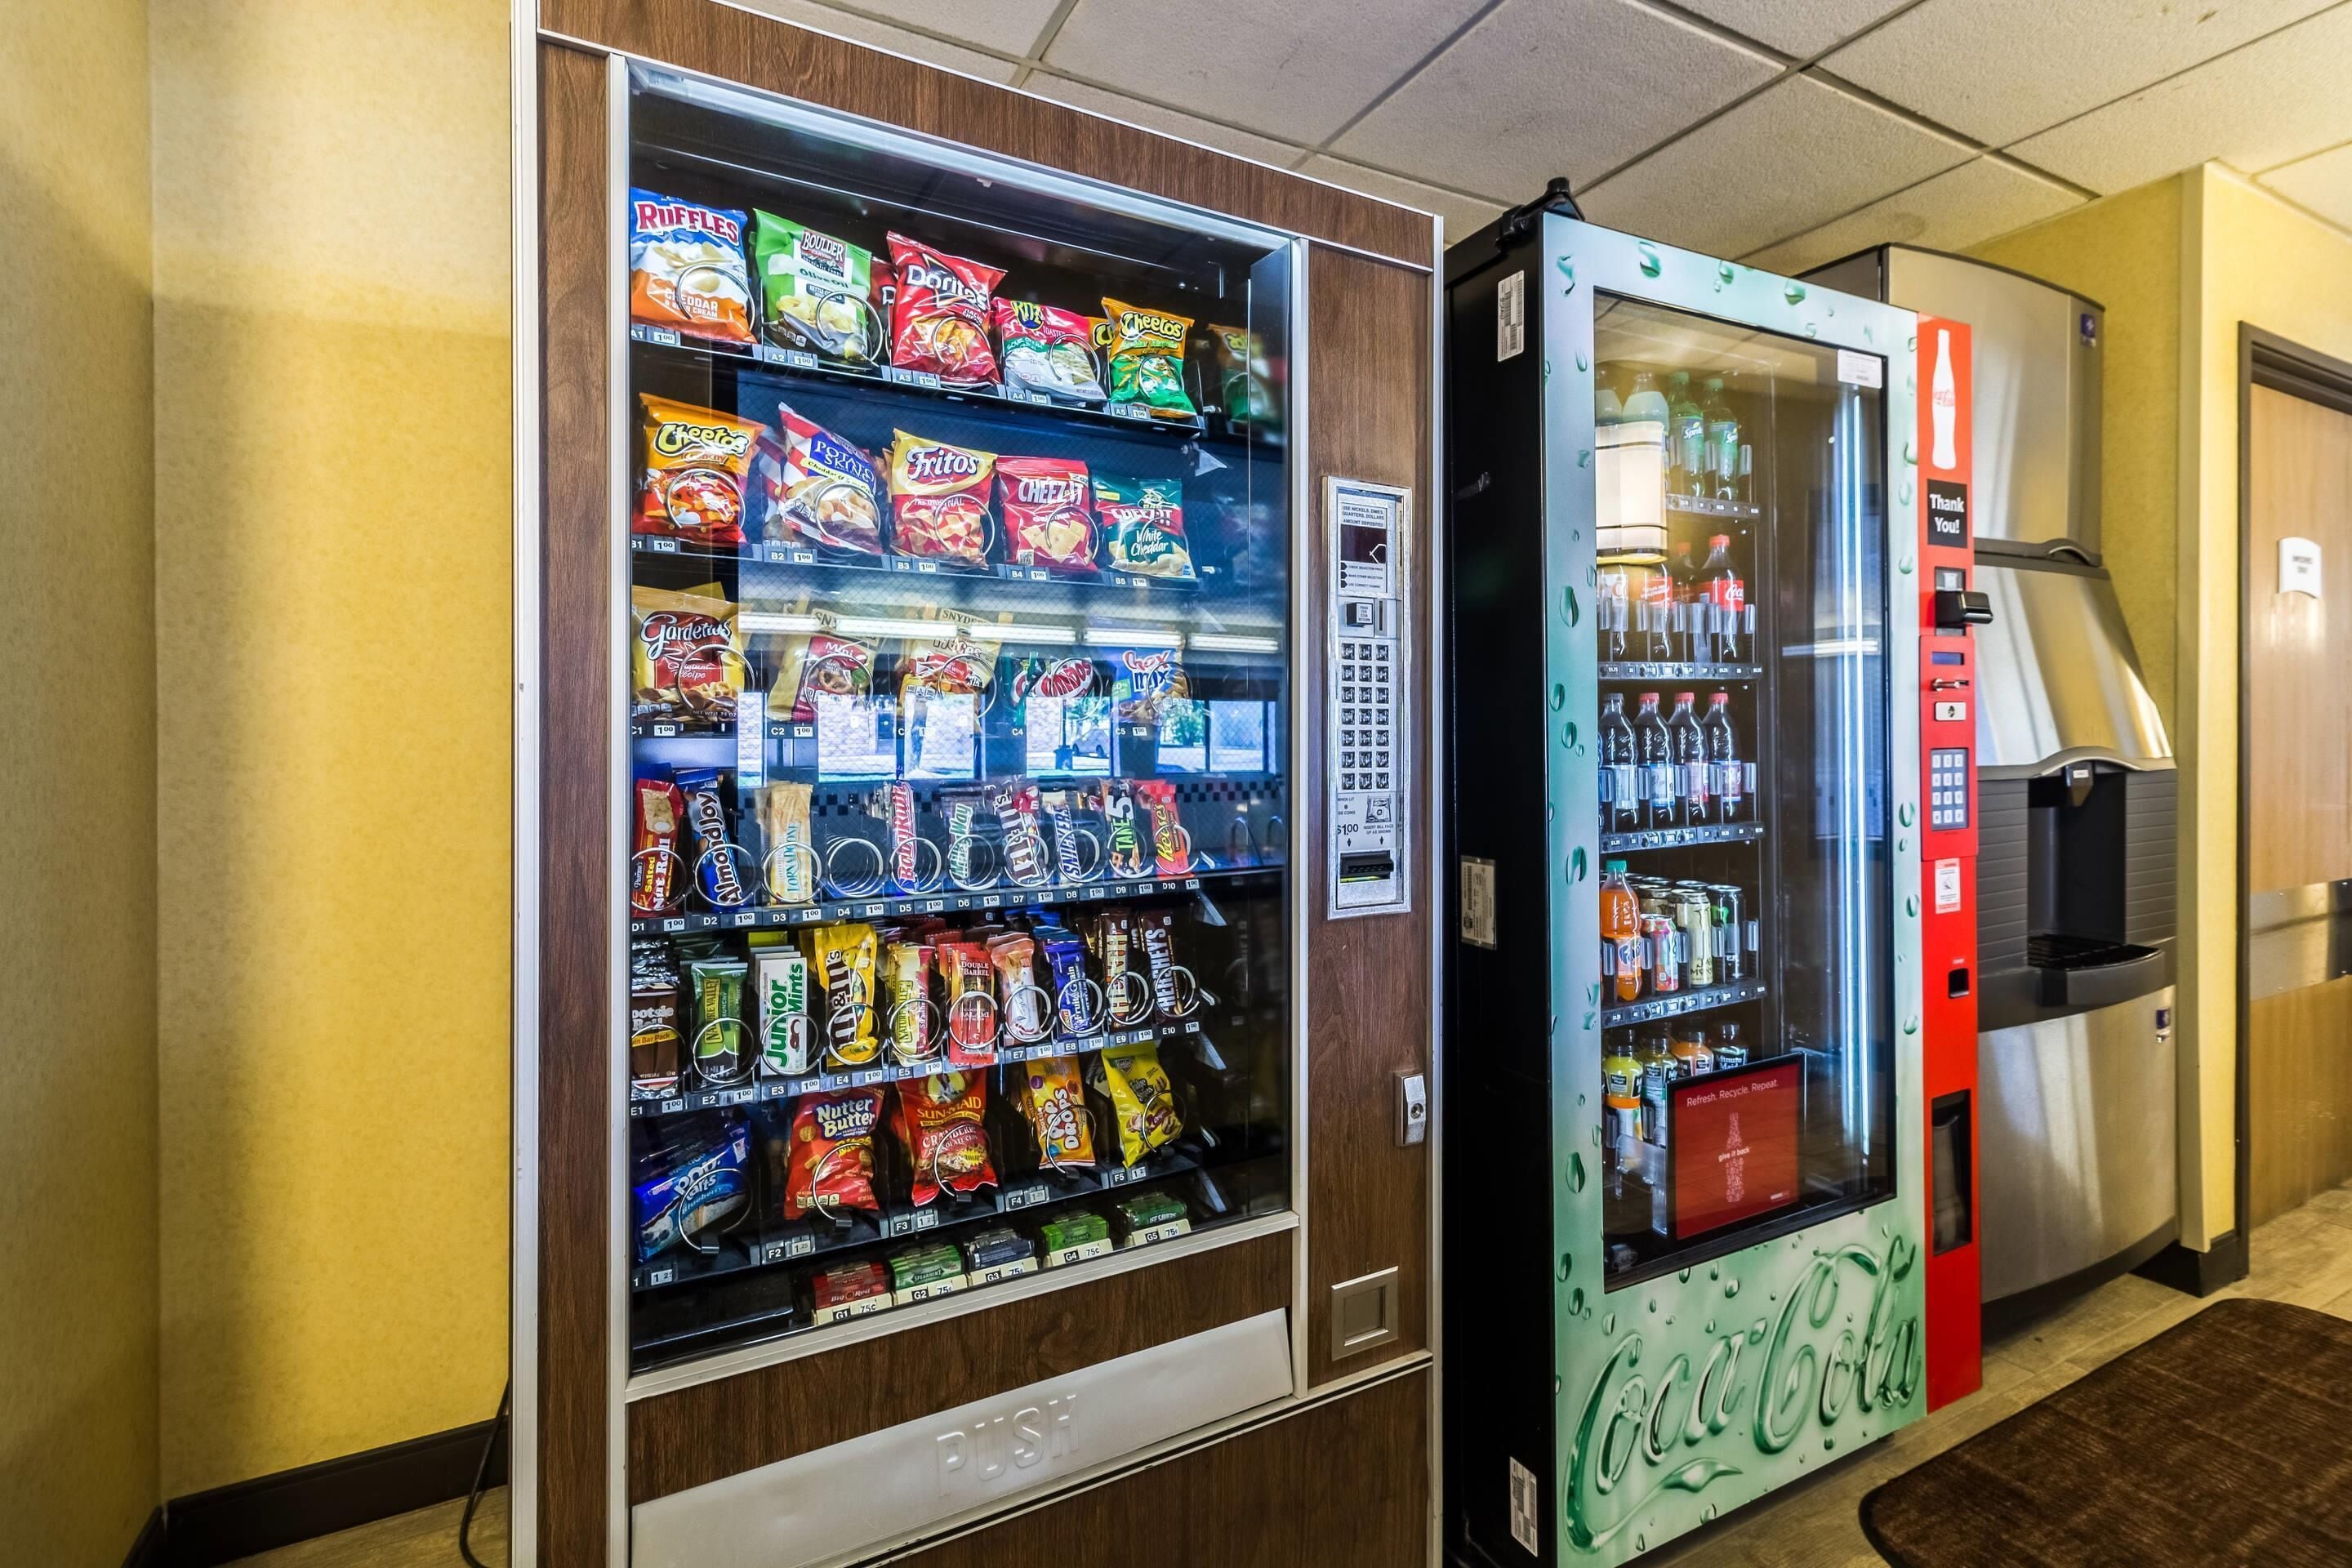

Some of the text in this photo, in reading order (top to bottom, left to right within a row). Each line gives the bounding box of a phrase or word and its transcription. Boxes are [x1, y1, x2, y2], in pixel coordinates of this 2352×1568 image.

[637, 203, 739, 243] RUFFLES
[804, 231, 844, 261] BOULDER
[800, 268, 849, 289] Olive Oil
[906, 264, 989, 313] Doritos
[693, 306, 718, 319] CREAM
[1121, 313, 1183, 340] Cheetos
[771, 354, 785, 362] A2
[899, 374, 911, 382] A3
[655, 422, 750, 457] Cheetos
[814, 440, 875, 482] POTATO
[906, 446, 979, 480] Fritos
[1929, 493, 1965, 513] Thank
[1361, 519, 1384, 528] DEPOSITED
[1934, 516, 1960, 535] You!
[1136, 529, 1163, 542] White
[1131, 541, 1169, 557] Cheddar
[771, 552, 784, 560] B2
[898, 561, 910, 570] B3
[1124, 650, 1171, 670] Chex
[771, 728, 784, 736] C2
[1106, 795, 1134, 819] 5
[1053, 804, 1081, 877] SNICKERS
[1111, 818, 1135, 851] TAKE
[655, 838, 670, 875] Roll
[702, 826, 742, 904] Almond
[644, 857, 656, 892] Salted
[786, 858, 801, 893] LORNA
[653, 875, 666, 910] Nut
[1162, 882, 1176, 890] D10
[773, 914, 786, 922] D3
[837, 908, 851, 916] D4
[703, 916, 718, 925] D2
[632, 923, 645, 932] D1
[961, 960, 989, 969] DOUBLE
[1145, 928, 1176, 1011] HERSHEY'S
[964, 968, 990, 976] BARREL
[705, 978, 720, 1007] VALLEY
[787, 962, 803, 1013] Mints
[766, 979, 789, 1067] Junior
[654, 1032, 670, 1041] Pack
[1162, 1027, 1176, 1035] E10
[836, 1076, 849, 1085] E4
[771, 1086, 785, 1094] E3
[1686, 1093, 1717, 1107] Refresh.
[1719, 1085, 1750, 1100] Recycle.
[702, 1095, 716, 1104] E2
[630, 1107, 643, 1116] E1
[816, 1098, 874, 1123] Nutter
[823, 1112, 876, 1138] Butter
[1054, 1088, 1080, 1150] DROPS
[1718, 1152, 1731, 1164] give
[1731, 1150, 1737, 1158] it
[1114, 1174, 1125, 1183] F5
[1011, 1197, 1022, 1206] F4
[896, 1222, 908, 1231] F3
[1146, 1232, 1159, 1241] G5
[768, 1248, 782, 1259] F2
[1064, 1253, 1078, 1262] G4
[913, 1270, 942, 1281] SPEARMINT
[987, 1272, 1000, 1282] G3
[831, 1288, 871, 1303] Big Red
[913, 1290, 928, 1300] G2
[835, 1310, 849, 1320] G1
[935, 1393, 1080, 1497] PUSH
